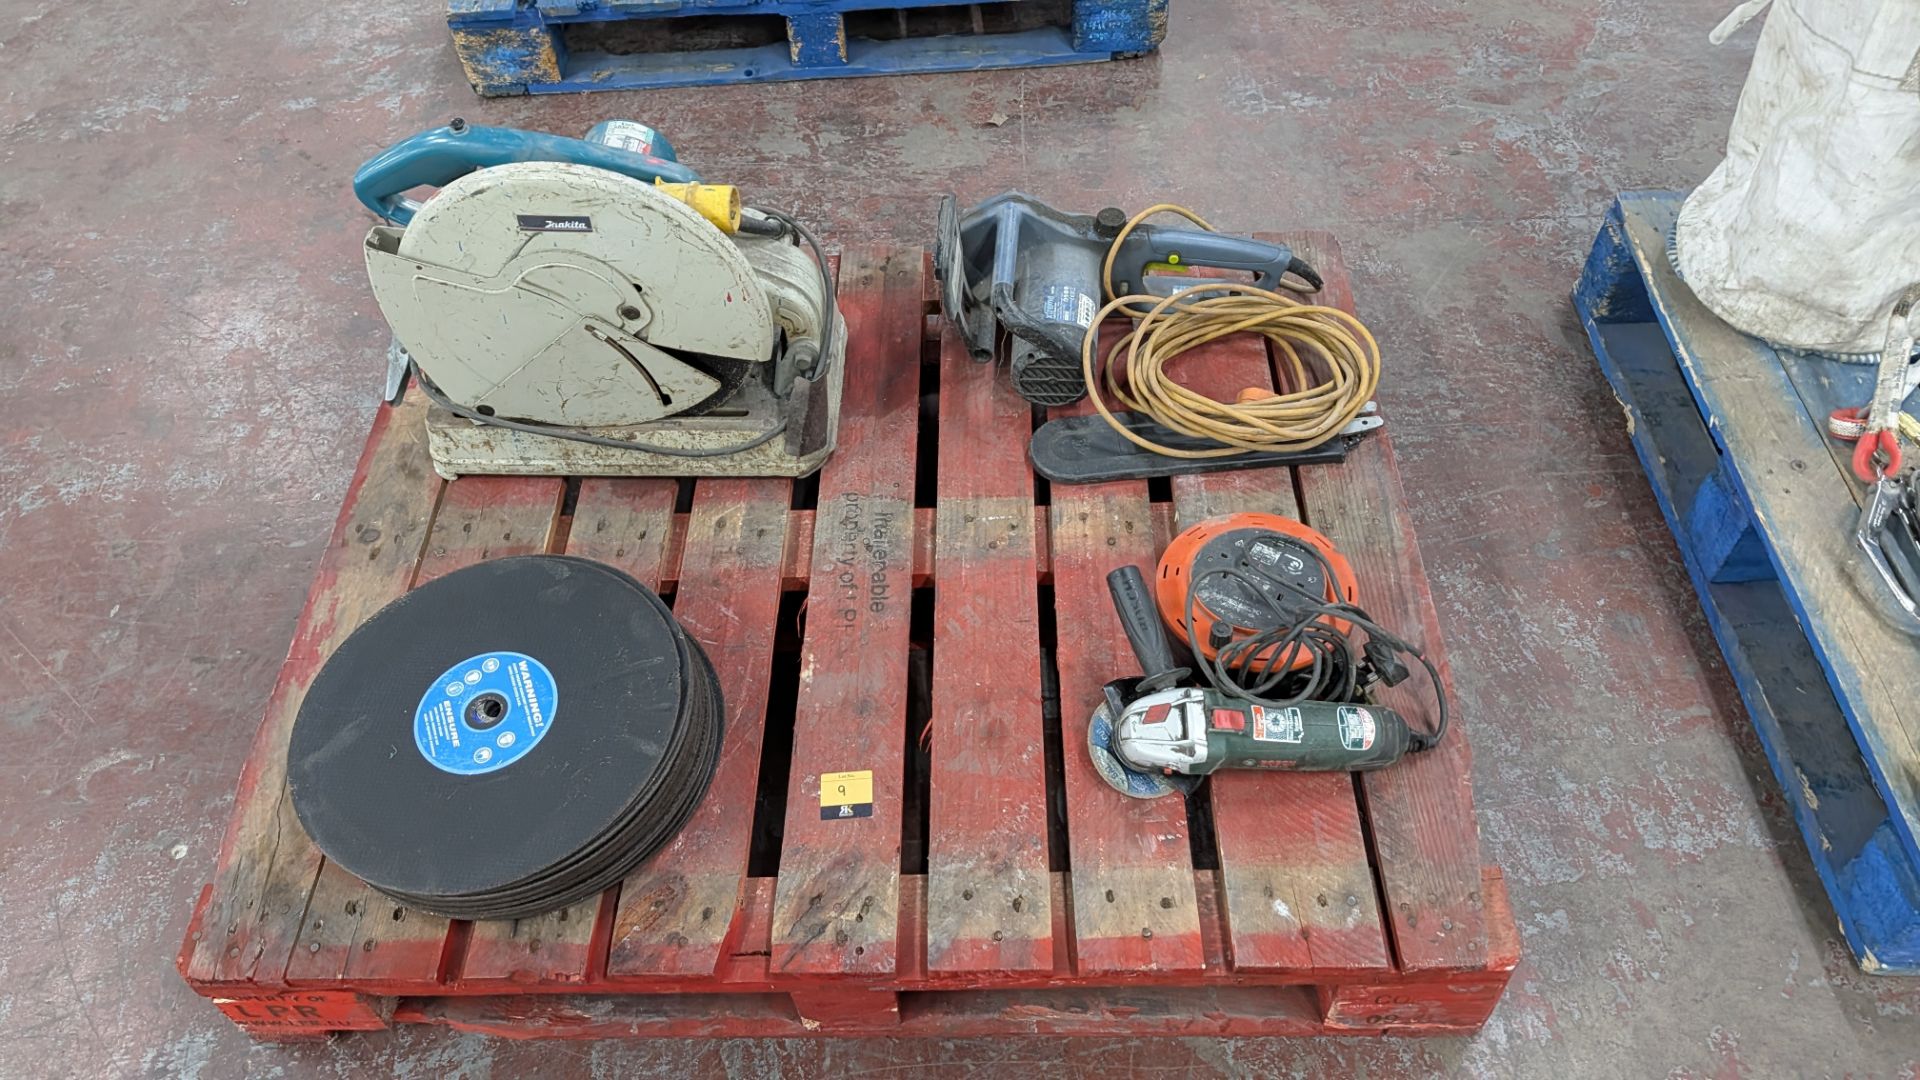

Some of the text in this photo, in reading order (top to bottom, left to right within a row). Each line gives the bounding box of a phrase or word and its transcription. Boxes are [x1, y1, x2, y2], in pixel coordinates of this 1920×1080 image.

[839, 571, 859, 589] of
[518, 660, 544, 728] WARNING!
[443, 700, 461, 748] ENSURE
[235, 1004, 322, 1019] LPR
